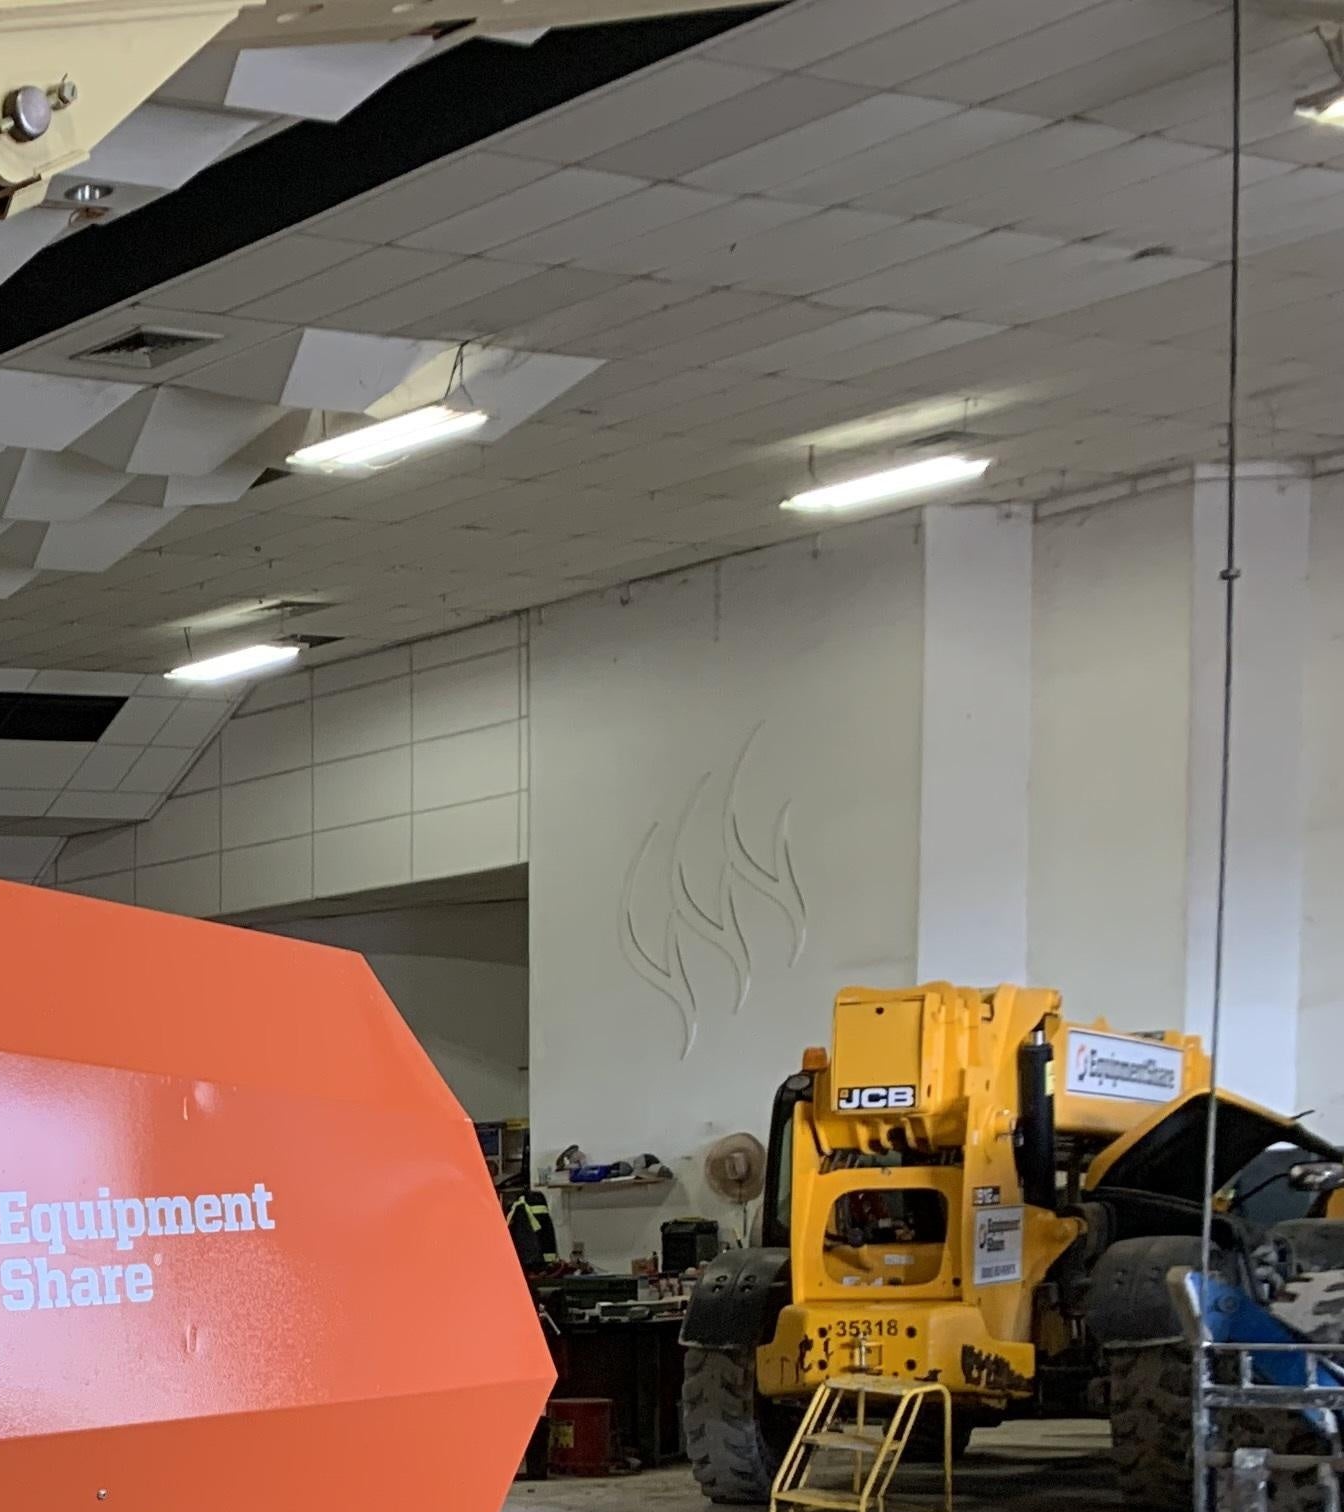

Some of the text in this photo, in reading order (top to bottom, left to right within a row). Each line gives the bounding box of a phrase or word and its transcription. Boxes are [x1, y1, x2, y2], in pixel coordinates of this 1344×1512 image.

[839, 1086, 914, 1109] JCB
[0, 1257, 154, 1311] Share
[836, 1319, 898, 1337] 35318
